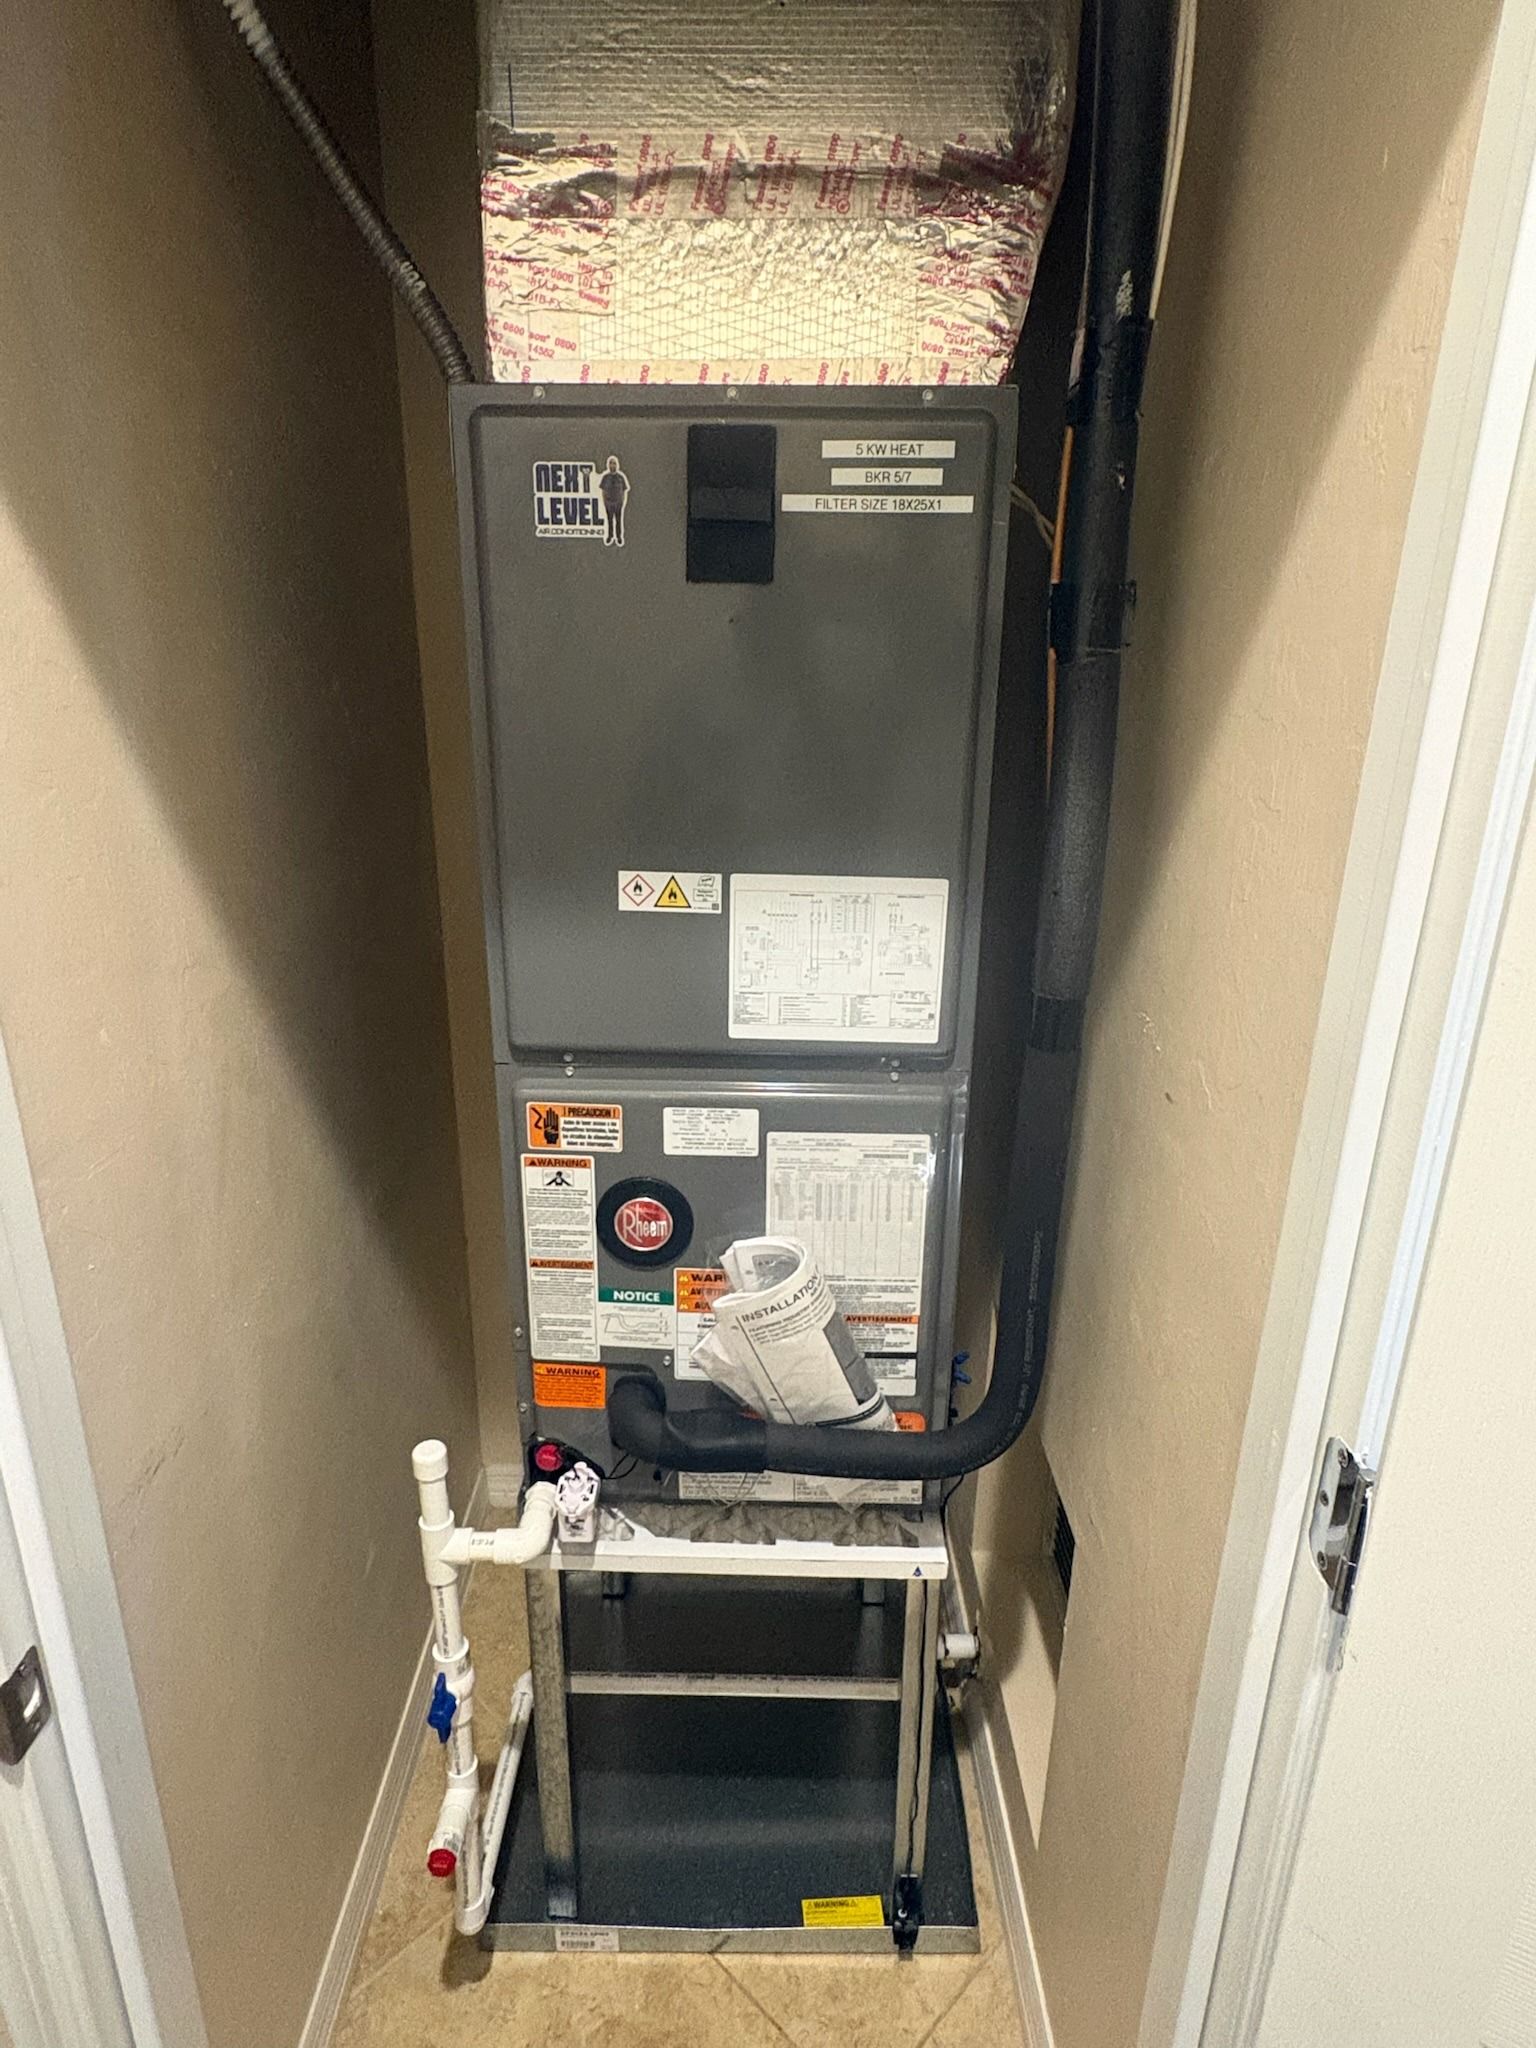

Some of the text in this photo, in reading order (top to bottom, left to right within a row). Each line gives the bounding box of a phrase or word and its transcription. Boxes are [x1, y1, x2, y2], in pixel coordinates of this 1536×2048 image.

[856, 444, 925, 456] 5 KW HEAT
[535, 464, 593, 493] NEXT
[865, 472, 912, 483] BKR 5/7
[815, 498, 942, 511] FILTER SIZE 18X25X1
[537, 497, 605, 526] LEVEL
[537, 1158, 587, 1168] WARNING
[622, 1203, 668, 1242] Rheem
[691, 1273, 727, 1283] WAR
[613, 1290, 661, 1303] NOTICE
[845, 1314, 913, 1323] AVERTISSEMENT
[545, 1367, 601, 1377] WARNING
[814, 1900, 850, 1908] WARNING
